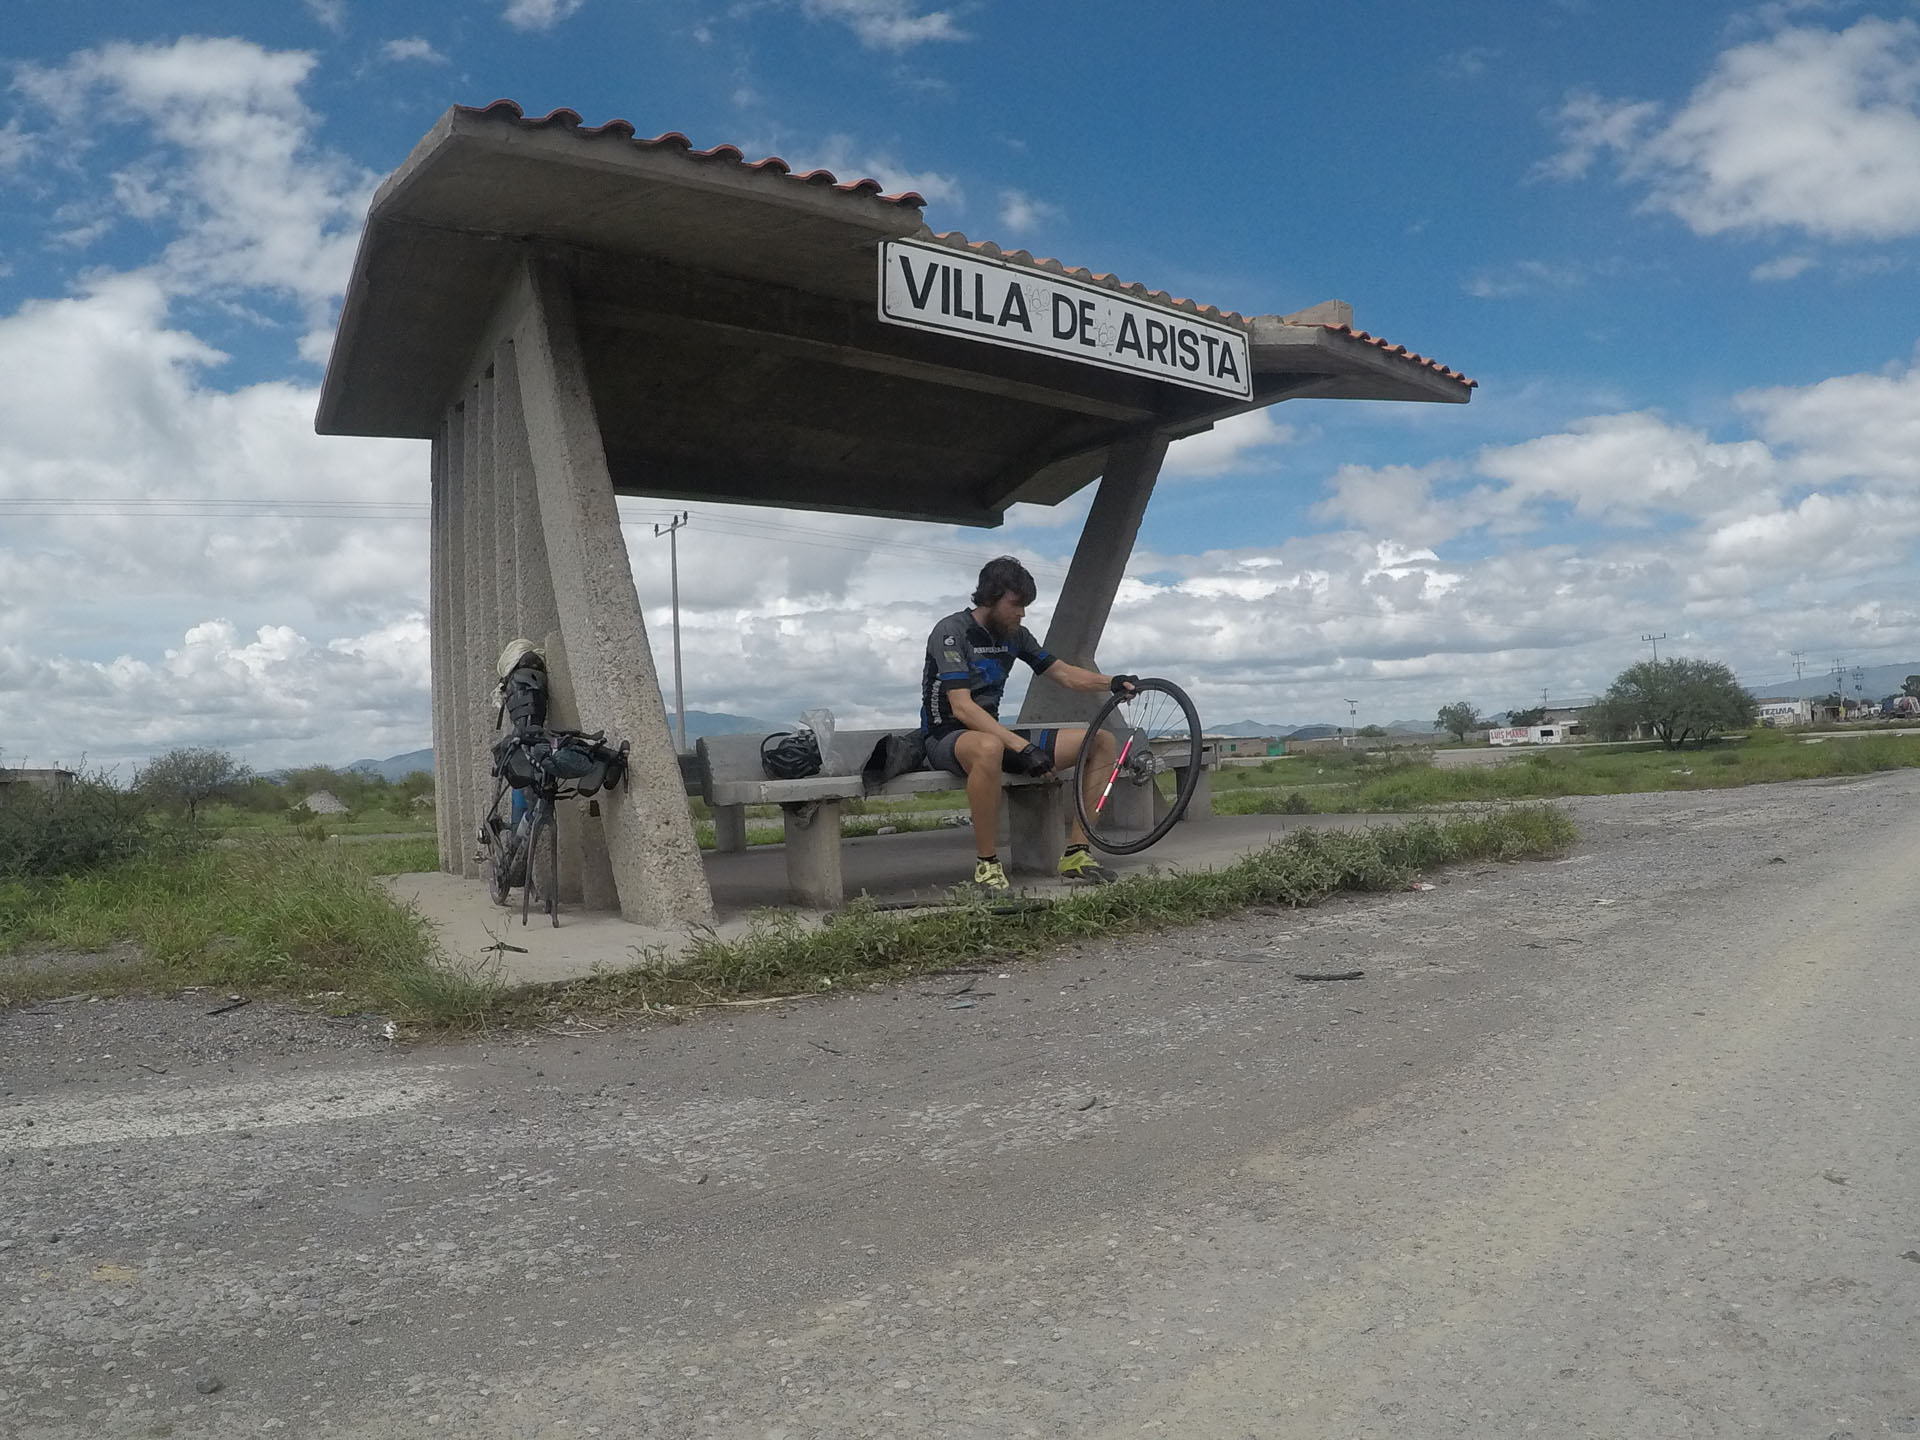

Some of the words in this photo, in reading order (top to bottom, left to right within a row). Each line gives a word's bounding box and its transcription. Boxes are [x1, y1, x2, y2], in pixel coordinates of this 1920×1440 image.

[899, 256, 1032, 332] VILLA
[1052, 292, 1096, 347] DE
[1116, 312, 1240, 383] ARISTA
